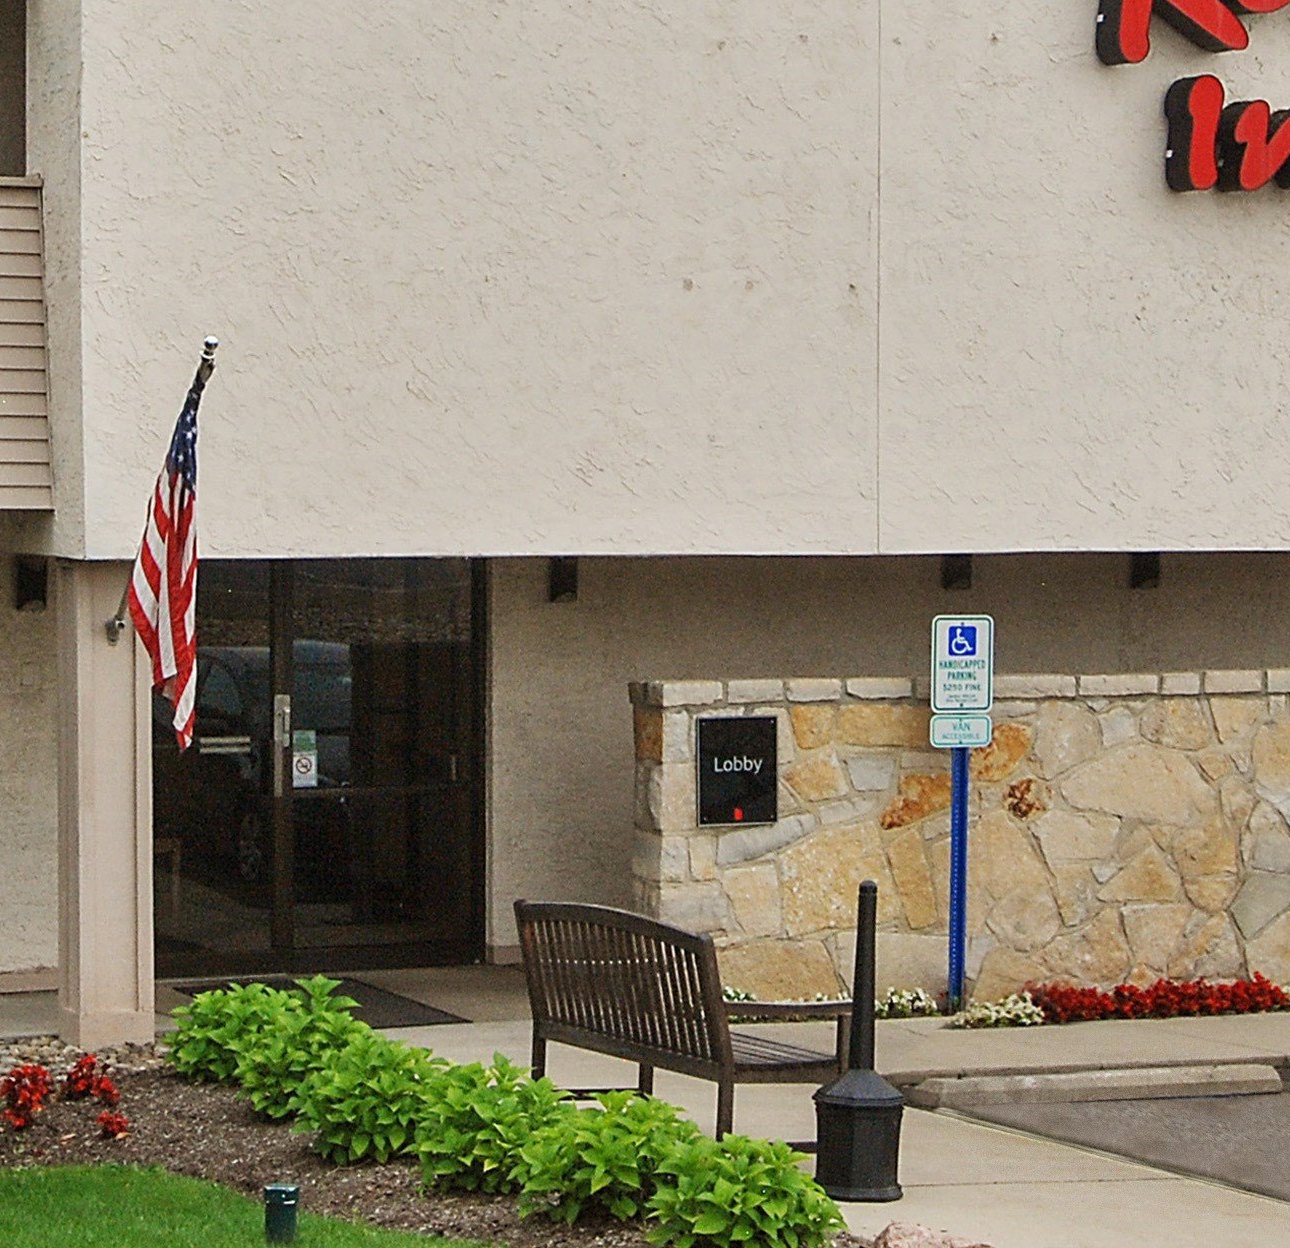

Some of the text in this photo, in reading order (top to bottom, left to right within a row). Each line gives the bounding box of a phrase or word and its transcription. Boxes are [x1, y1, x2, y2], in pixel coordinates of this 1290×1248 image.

[947, 671, 977, 680] PARKING
[952, 722, 971, 731] VAN
[714, 755, 763, 775] Lobby
